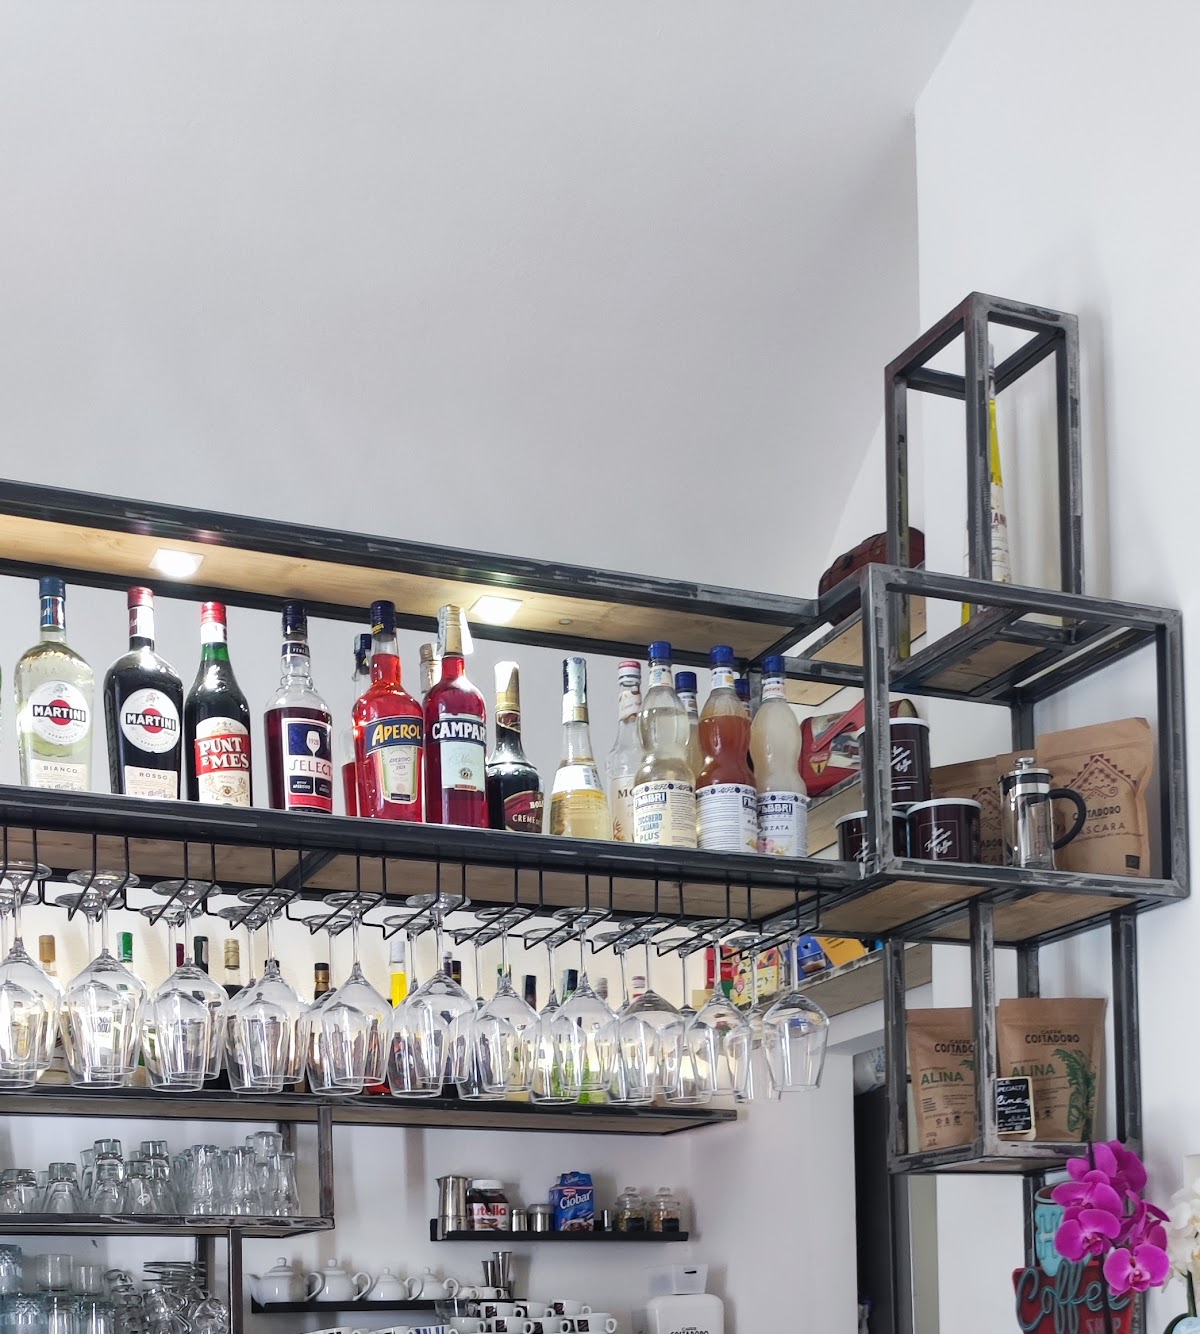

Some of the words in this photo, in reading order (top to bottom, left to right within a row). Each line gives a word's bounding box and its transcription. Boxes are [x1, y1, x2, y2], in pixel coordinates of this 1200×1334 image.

[33, 705, 87, 723] MARTINI
[126, 713, 177, 731] MARTINI
[372, 724, 422, 747] APEROL
[432, 722, 486, 740] CAMPAR
[198, 737, 243, 756] PUNT
[210, 753, 250, 769] MES
[289, 759, 333, 775] SELECT
[43, 765, 78, 774] BIANCO
[139, 772, 168, 780] ROSSO
[1073, 805, 1121, 821] CTADORO
[640, 832, 660, 842] PLUS
[1025, 1034, 1080, 1043] COSTADORO
[934, 1043, 975, 1053] COSTADO
[921, 1071, 964, 1085] ALINA
[1012, 1063, 1056, 1077] ALINA
[560, 1190, 592, 1209] Ciobar
